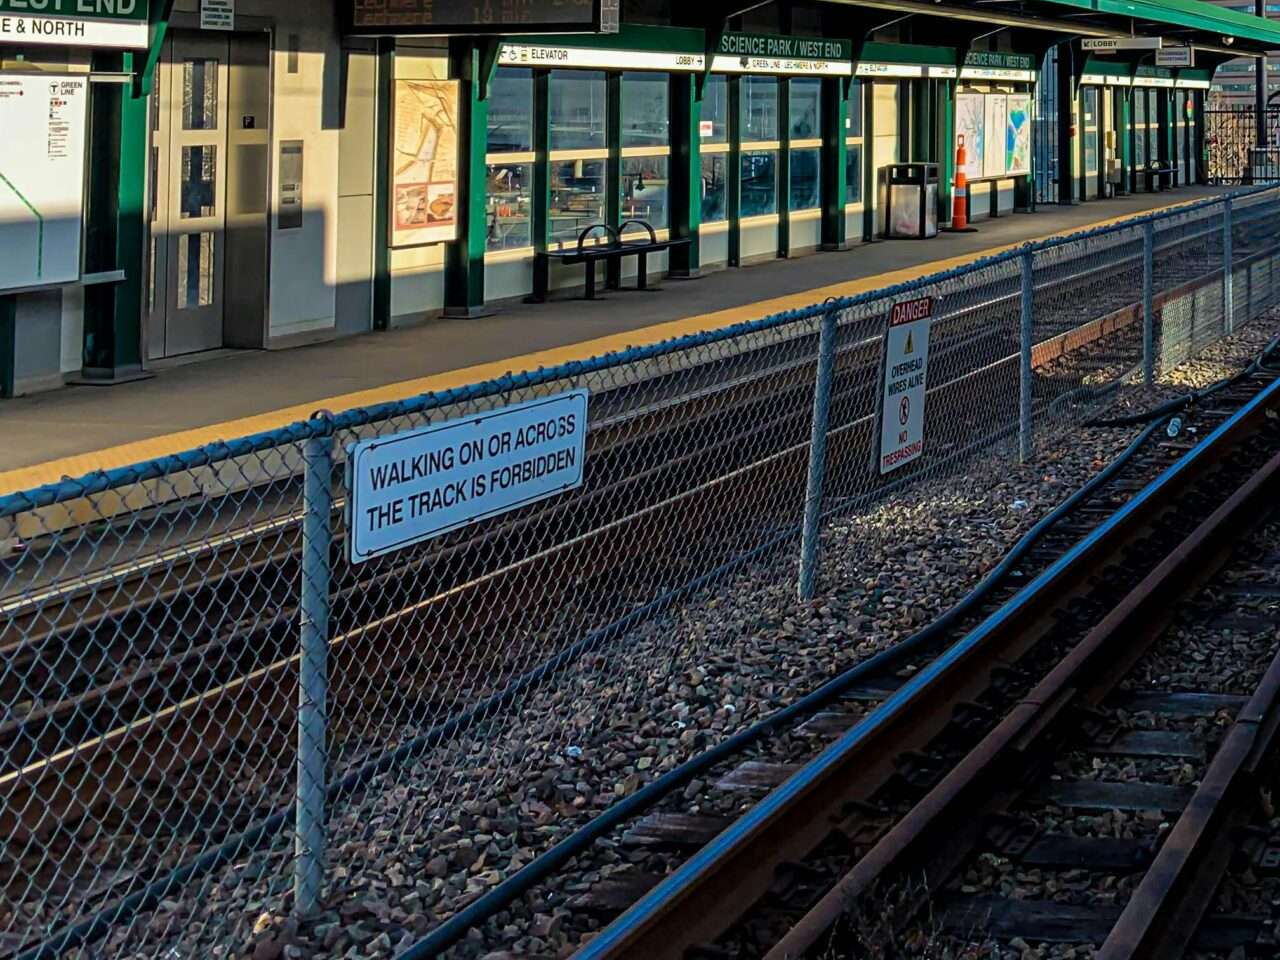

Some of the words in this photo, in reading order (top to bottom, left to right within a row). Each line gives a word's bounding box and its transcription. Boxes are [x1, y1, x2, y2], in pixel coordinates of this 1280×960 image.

[16, 19, 26, 33] &
[32, 20, 85, 37] NORTH
[531, 48, 568, 60] ELEVATOR
[721, 36, 765, 54] SCIENCE
[767, 40, 792, 56] PARK
[799, 41, 823, 57] WEST
[825, 43, 842, 58] END
[676, 56, 695, 66] LOBBY
[60, 81, 83, 89] GREEN
[893, 298, 929, 324] DANGER
[891, 357, 923, 378] OVERHEAD
[888, 378, 907, 396] WIRES
[907, 372, 925, 389] ALIVE
[898, 430, 908, 444] NO
[371, 447, 454, 490] WALKING
[459, 441, 483, 465] ON
[488, 431, 512, 457] OR
[514, 414, 575, 450] ACROSS
[882, 441, 922, 467] TRESPASSING
[367, 499, 403, 531] THE
[408, 479, 468, 518] TRACK
[470, 474, 486, 499] IS
[490, 446, 576, 493] FORBIDDEN
